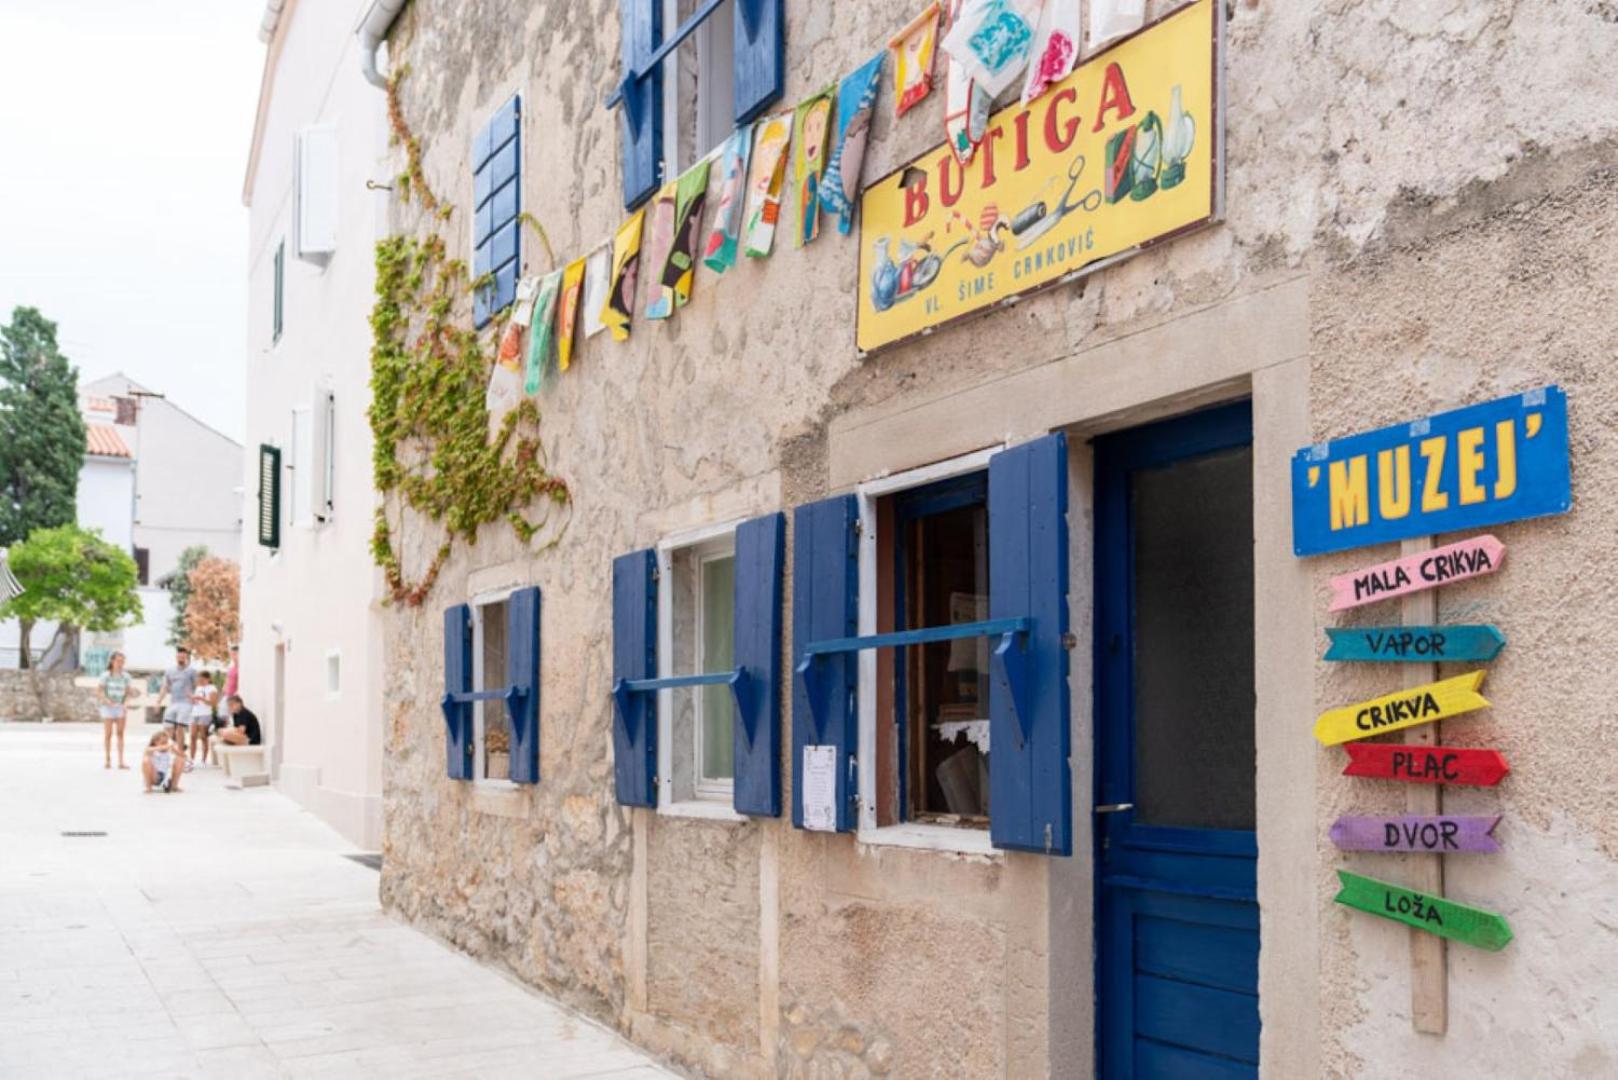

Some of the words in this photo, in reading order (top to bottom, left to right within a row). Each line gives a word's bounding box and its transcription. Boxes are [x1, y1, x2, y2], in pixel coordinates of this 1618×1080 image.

[903, 62, 1136, 228] BUTIGA
[959, 272, 995, 301] ŠIME
[1014, 228, 1095, 279] CRNKOVIĆ
[1354, 566, 1411, 600] MALA
[1420, 547, 1492, 582] CRIKVA
[1366, 632, 1446, 656] VAPOR
[1356, 692, 1440, 731] CRIKVA
[1393, 752, 1459, 781] PLAC
[1384, 821, 1460, 849] DVOR
[1385, 890, 1443, 926] LOŽA
